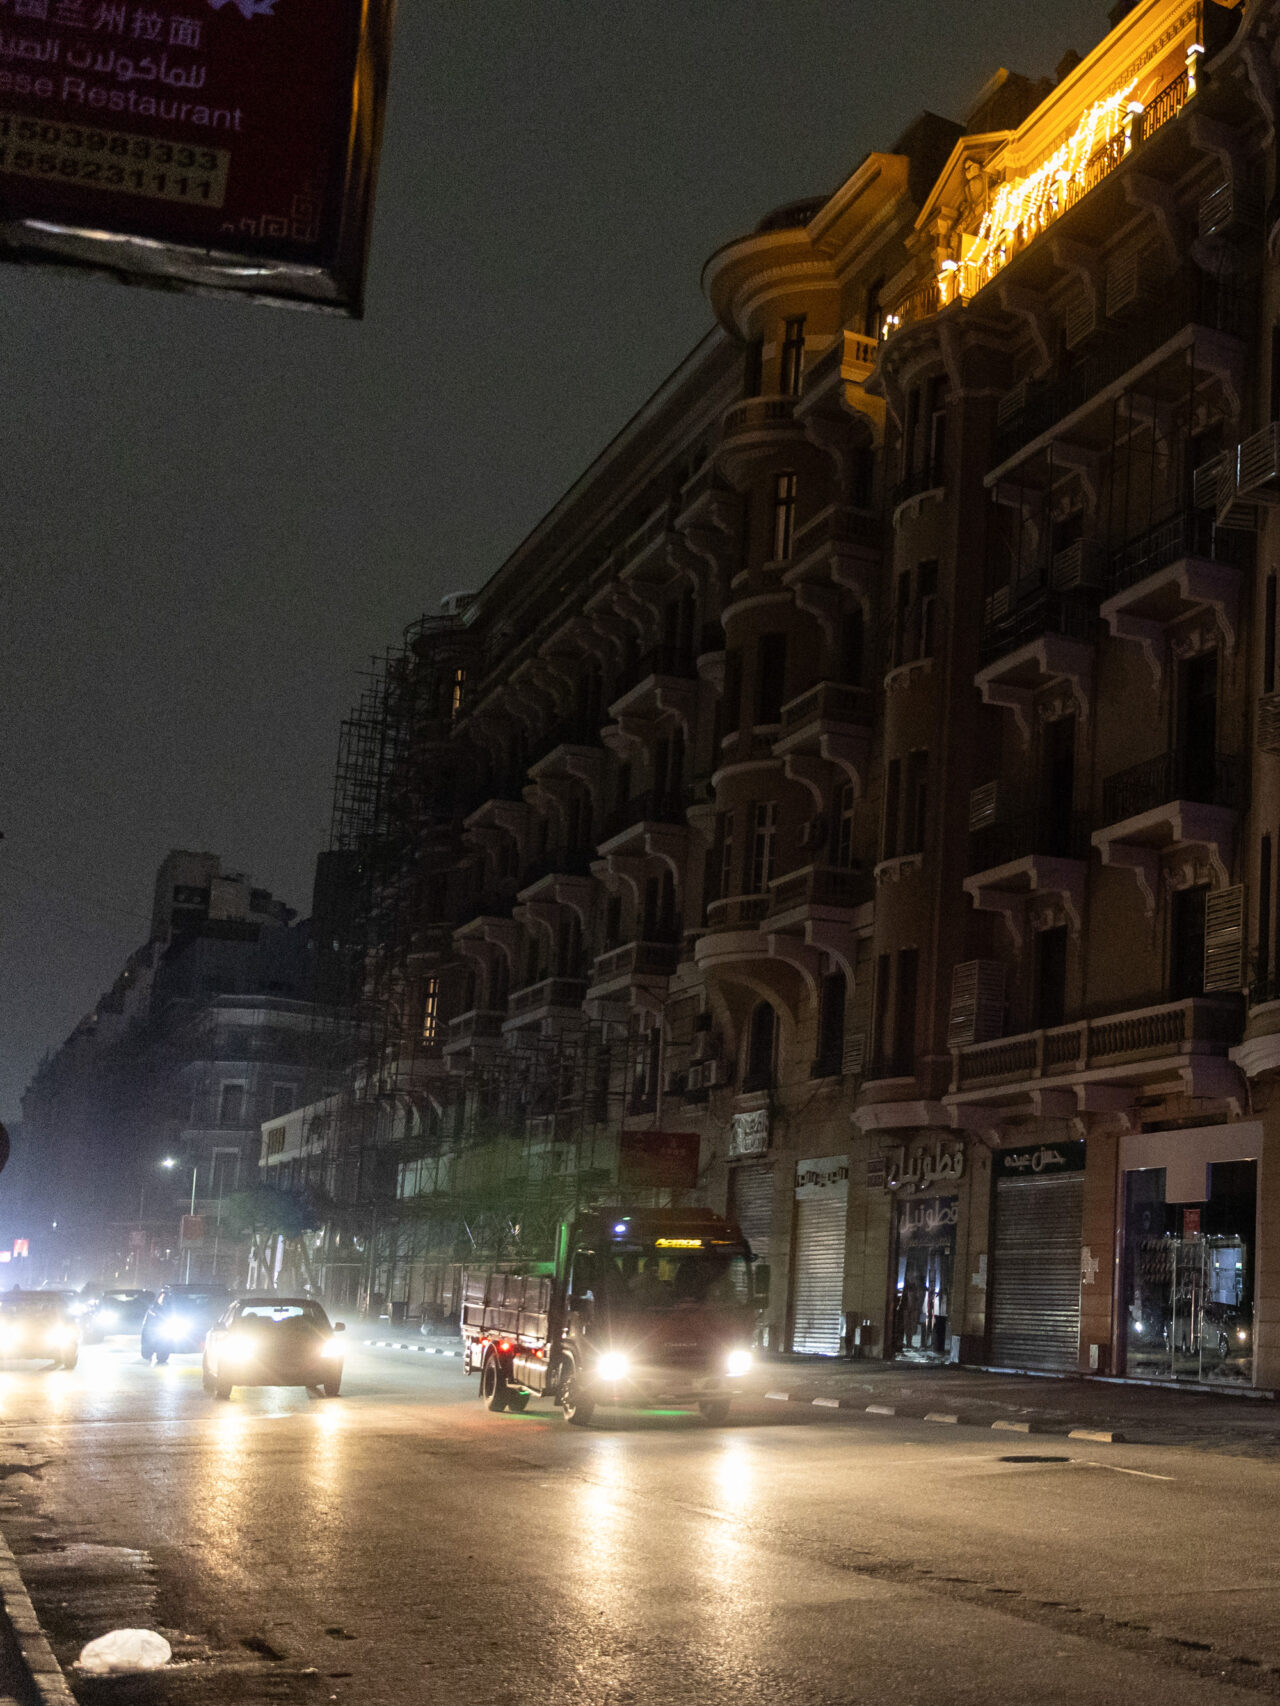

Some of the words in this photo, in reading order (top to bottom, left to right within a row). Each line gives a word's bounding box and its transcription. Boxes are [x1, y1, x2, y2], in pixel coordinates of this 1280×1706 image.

[0, 0, 203, 49] 国兰州拉面
[61, 76, 244, 131] Restaurant
[887, 1142, 965, 1192] قطونيل
